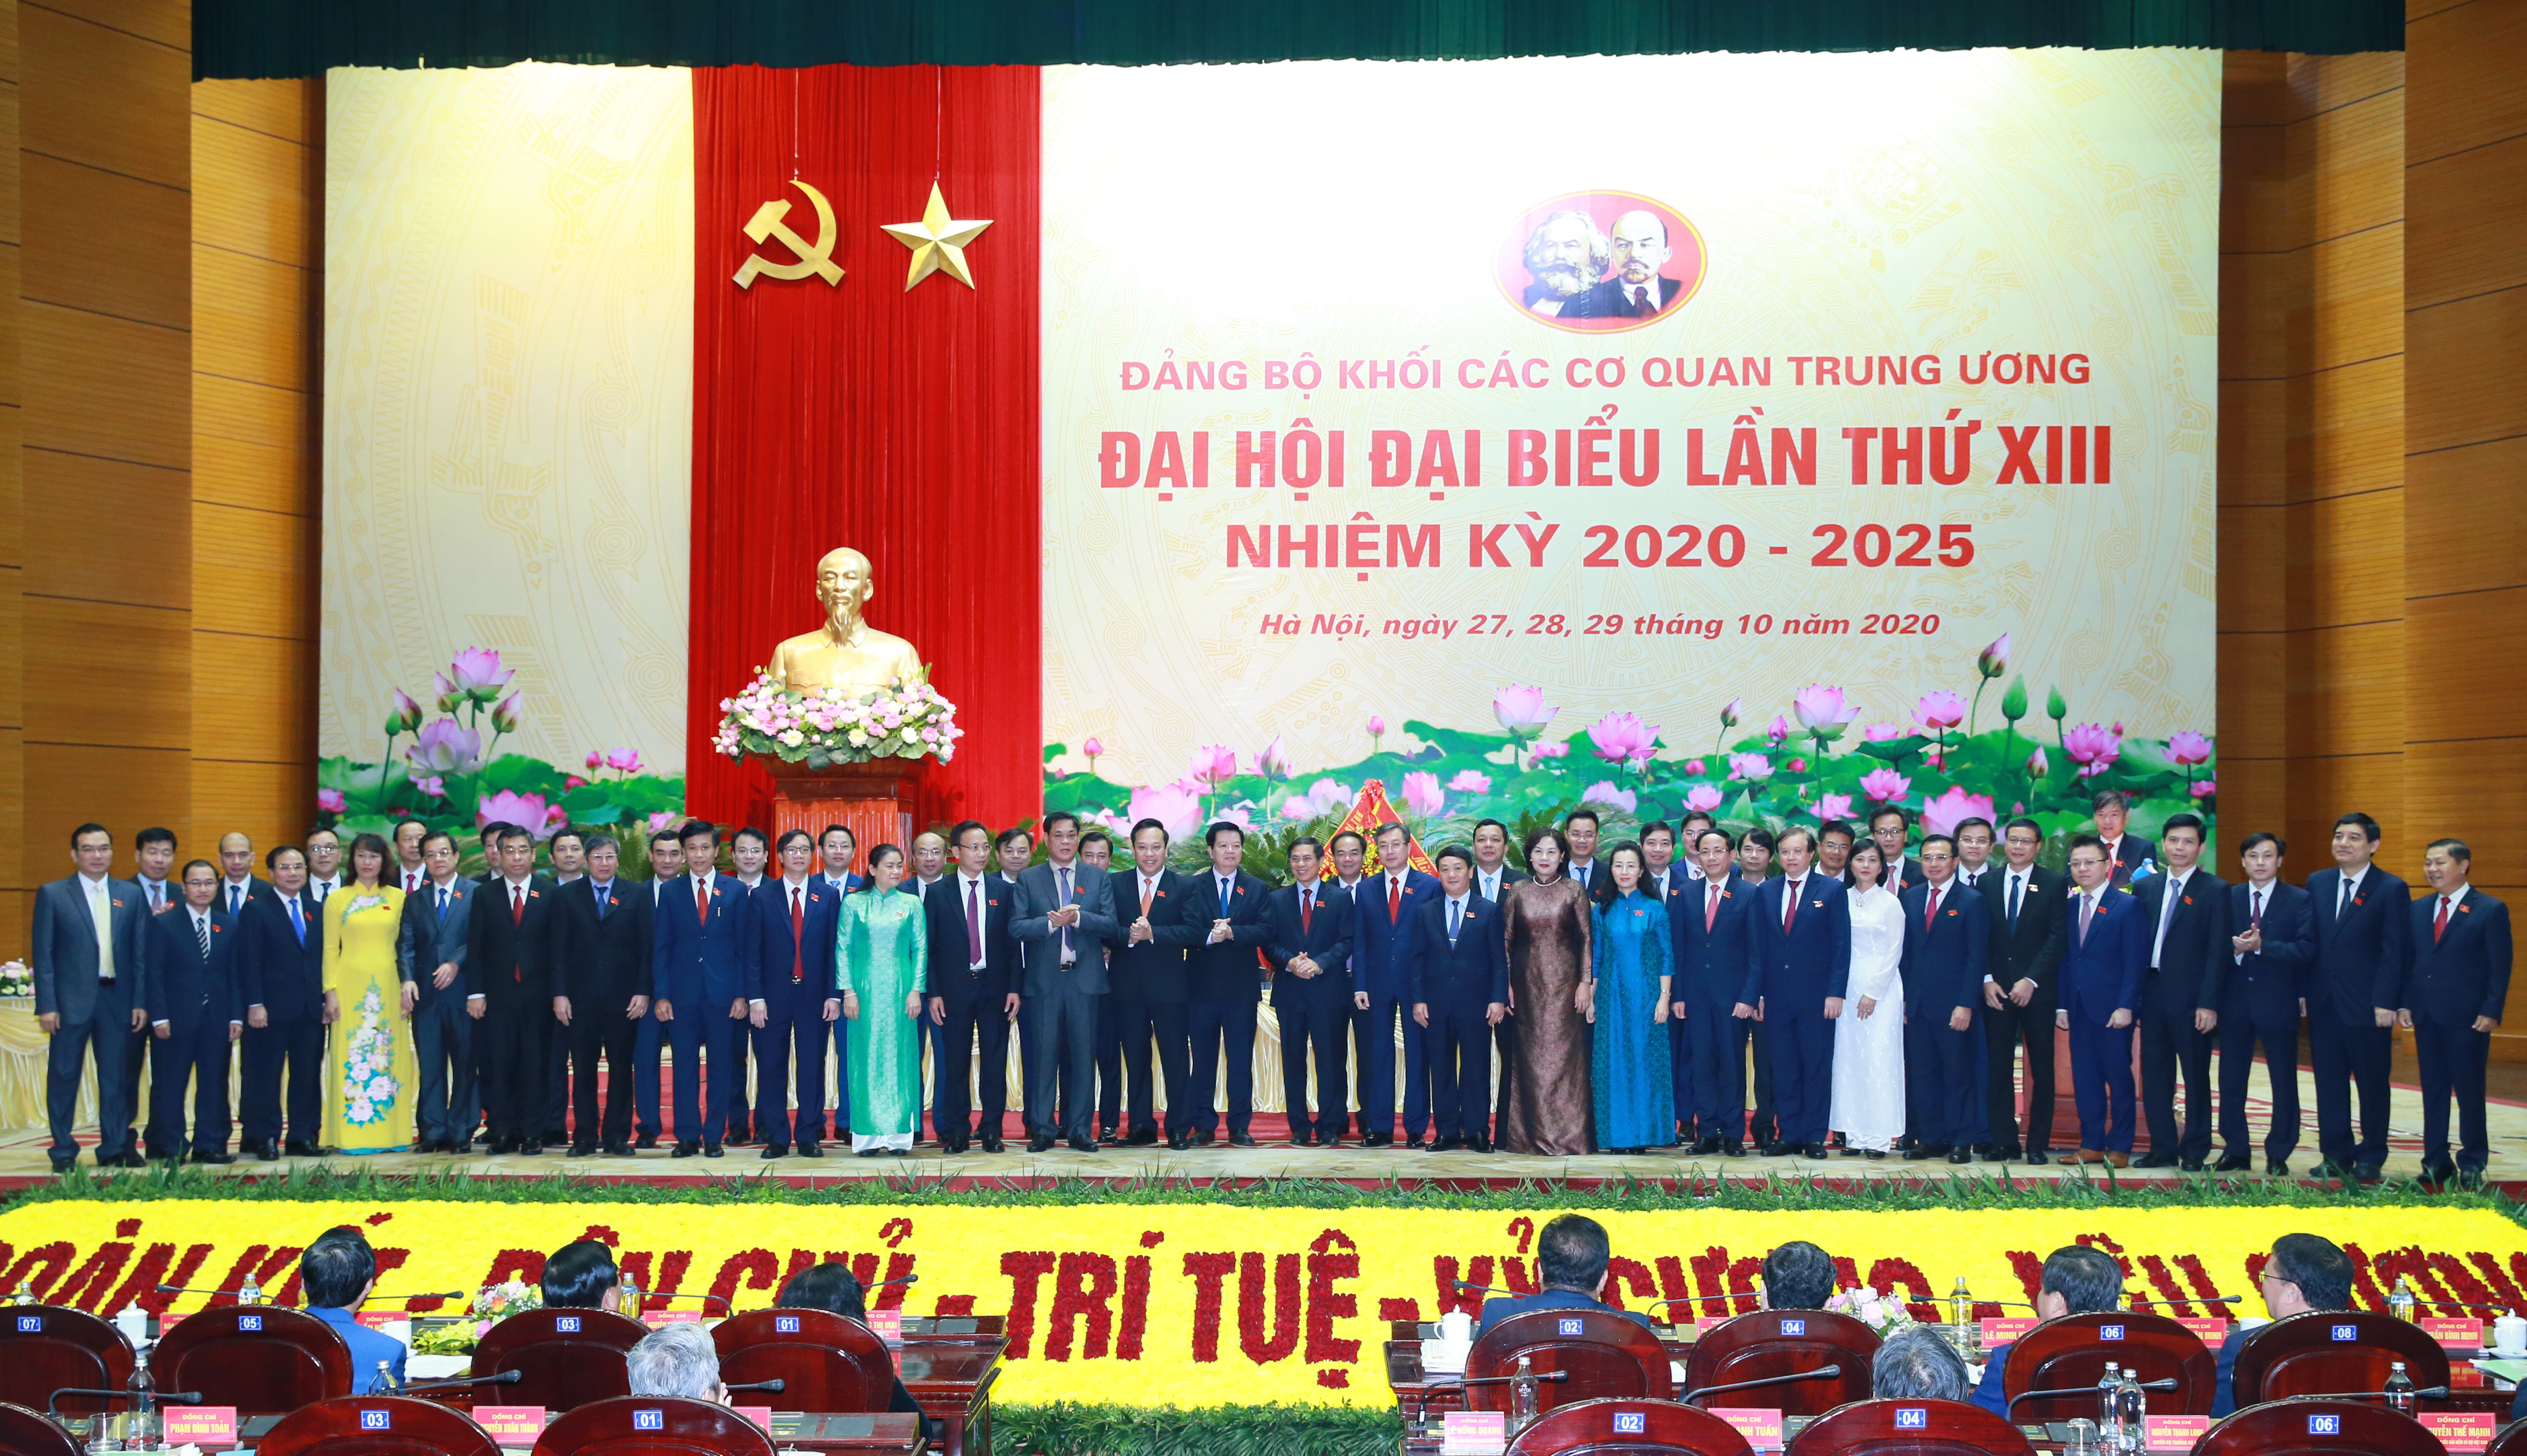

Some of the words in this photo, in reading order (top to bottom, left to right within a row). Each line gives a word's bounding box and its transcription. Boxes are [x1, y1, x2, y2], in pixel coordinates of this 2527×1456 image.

[1120, 348, 1247, 390] ĐẢNG
[1265, 352, 1322, 400] BỘ
[1339, 346, 1440, 389] KHỐI
[1458, 350, 1549, 389] CÁC
[1566, 356, 1625, 388] CƠ
[1642, 356, 1771, 388] QUAN
[1787, 354, 1941, 386] TRUNG
[1959, 350, 2090, 385] ƯƠNG
[1099, 431, 1209, 501] ĐẠI
[1236, 418, 1344, 501] HỘI
[1369, 429, 1481, 501] ĐẠI
[1508, 403, 1659, 487] BIỂU
[1687, 406, 1817, 486] LẦN
[1842, 408, 1981, 485] THỨ
[1996, 426, 2111, 485] XIII
[1227, 512, 1440, 582] NHIỆM
[1470, 512, 1560, 567] KỲ
[1584, 524, 1745, 568] 2020
[1811, 524, 1974, 567] 2025
[1260, 614, 1301, 635] Hà
[1311, 614, 1370, 641] Nội,
[1383, 614, 1458, 639] ngày
[1468, 614, 1513, 637] 27,
[1526, 614, 1571, 637] 28,
[1584, 614, 1623, 635] 29
[1635, 613, 1723, 639] tháng
[1739, 614, 1772, 634] 10
[1783, 613, 1850, 634] năm
[1860, 614, 1940, 635] 2020
[0, 1218, 214, 1318] OÀN
[1000, 1230, 1165, 1362] TRÍ
[1182, 1228, 1361, 1389] TUỆ
[23, 1319, 36, 1329] 07
[243, 1318, 257, 1328] 05
[561, 1319, 575, 1330] 03
[781, 1319, 795, 1330] 01
[873, 1322, 883, 1330] THỊ
[1564, 1321, 1578, 1333] 02
[1786, 1322, 1800, 1334] 04
[1985, 1330, 1994, 1339] LÊ
[1996, 1331, 2017, 1340] MINH
[2105, 1327, 2119, 1338] 06
[2204, 1331, 2222, 1340] MINH
[2337, 1327, 2351, 1338] 08
[367, 1413, 384, 1427] 03
[640, 1413, 656, 1427] 01
[1621, 1416, 1638, 1430] 02
[1902, 1411, 1920, 1425] 04
[170, 1423, 191, 1435] PHẠM
[503, 1422, 519, 1433] XUÂN
[1478, 1426, 1502, 1435] QUANG
[1755, 1423, 1778, 1436] TUẤN
[2315, 1417, 2333, 1432] 06
[2428, 1424, 2451, 1436] GUYỄN
[2453, 1425, 2467, 1436] THẾ
[2469, 1428, 2491, 1438] MẠNH
